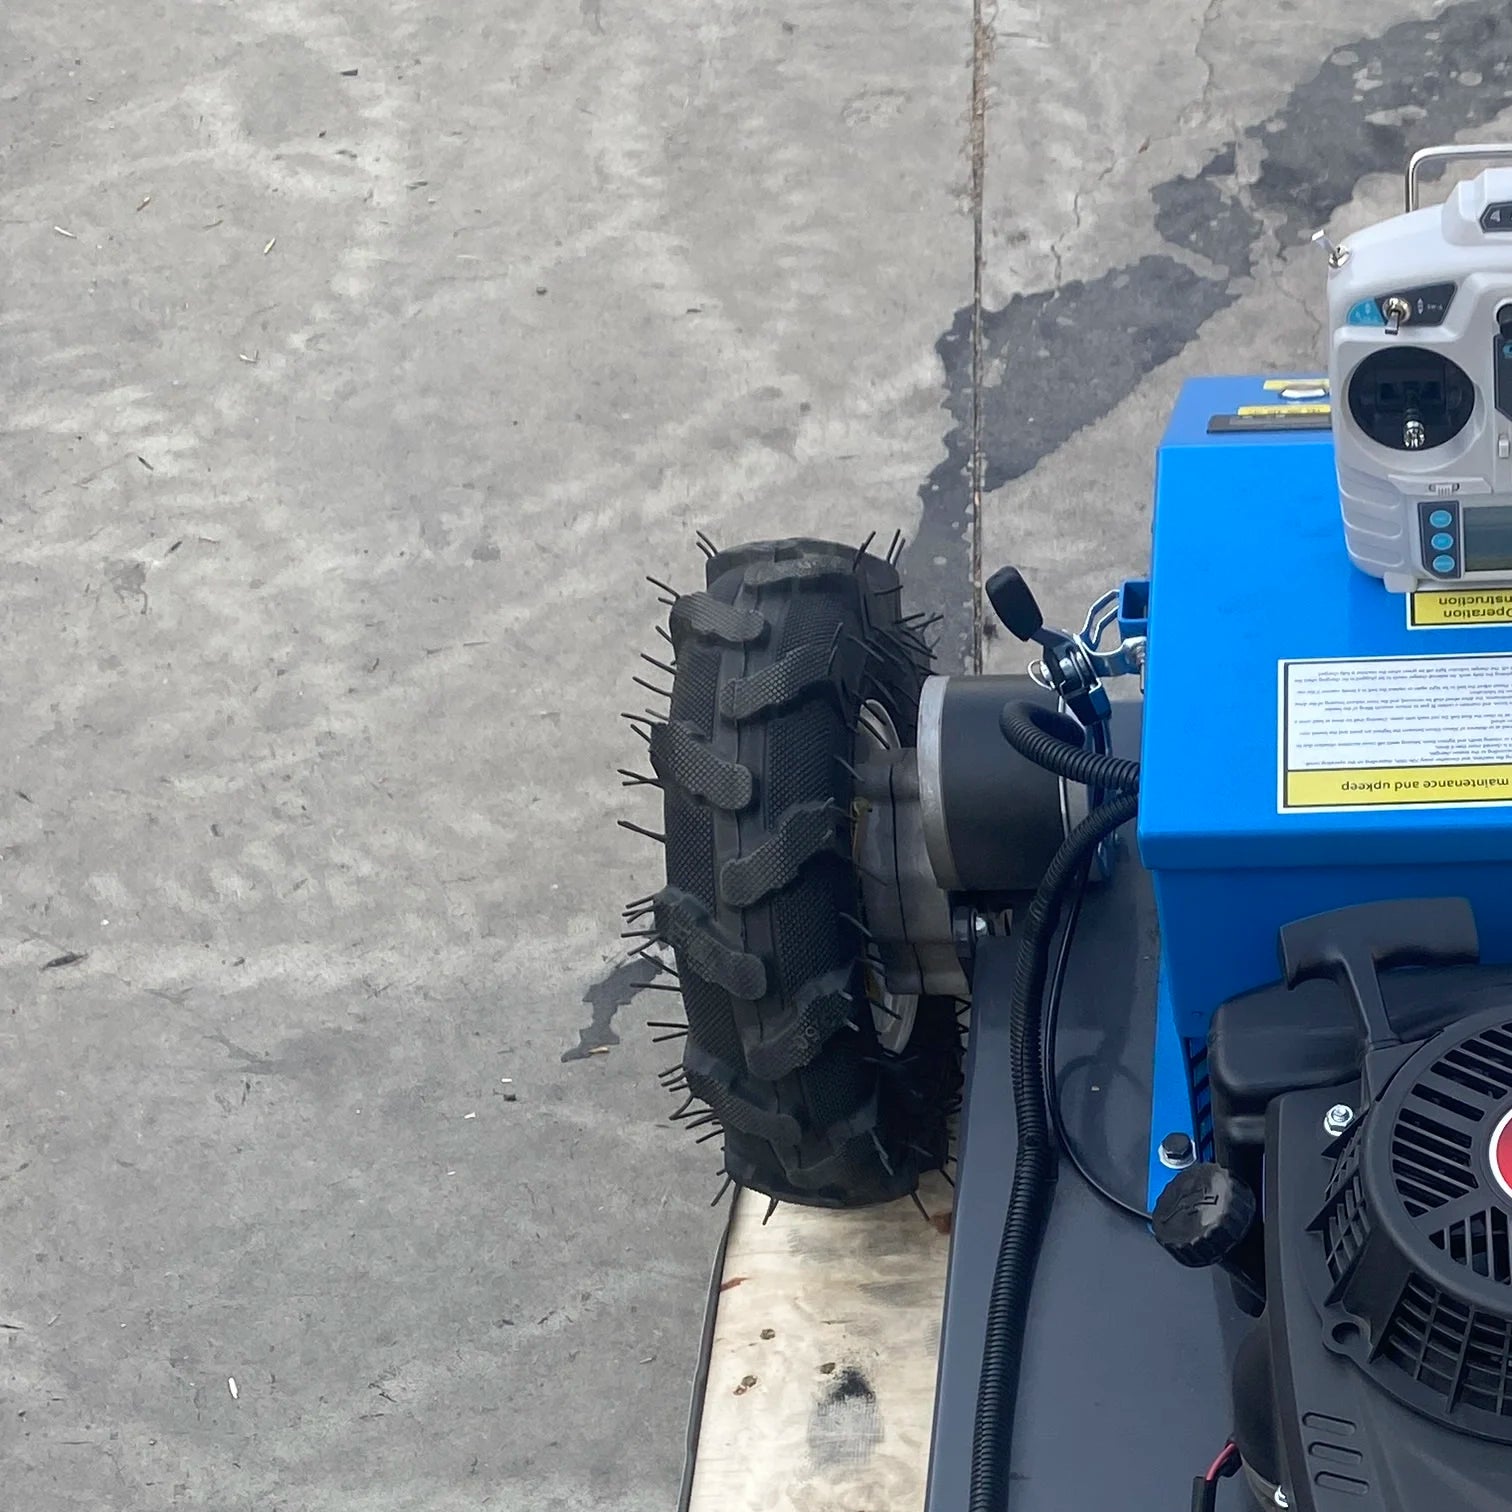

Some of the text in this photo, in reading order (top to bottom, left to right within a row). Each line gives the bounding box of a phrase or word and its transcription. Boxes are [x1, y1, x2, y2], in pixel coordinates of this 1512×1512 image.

[1342, 782, 1390, 791] upkeep
[1395, 782, 1419, 791] and
[1424, 779, 1508, 787] maintenance
